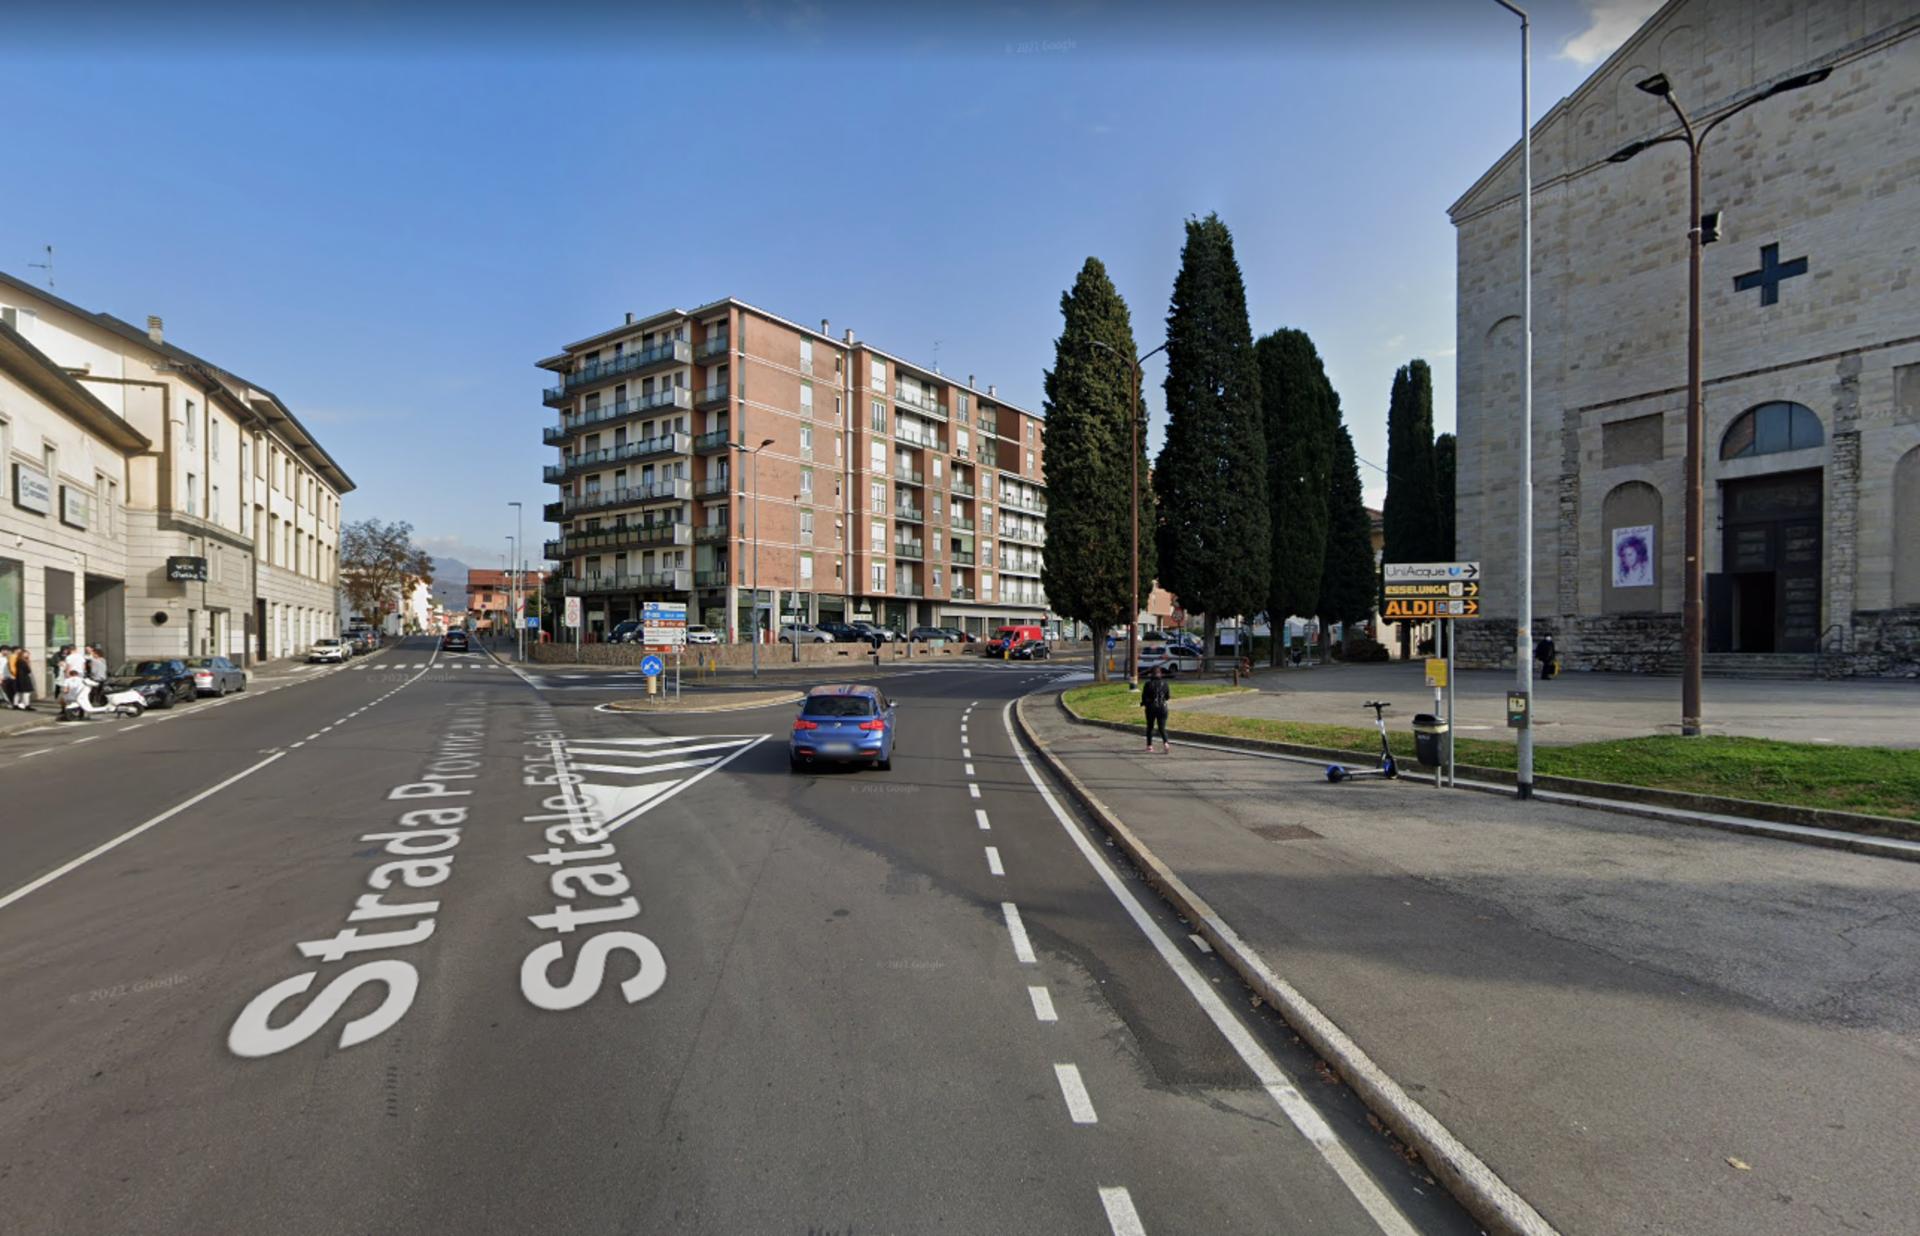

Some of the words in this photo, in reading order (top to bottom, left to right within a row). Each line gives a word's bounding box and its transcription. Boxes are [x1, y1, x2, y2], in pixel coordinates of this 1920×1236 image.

[1385, 565, 1446, 578] UniAcque
[1385, 585, 1448, 595] ESSELUNGA
[1385, 600, 1435, 615] ALDI
